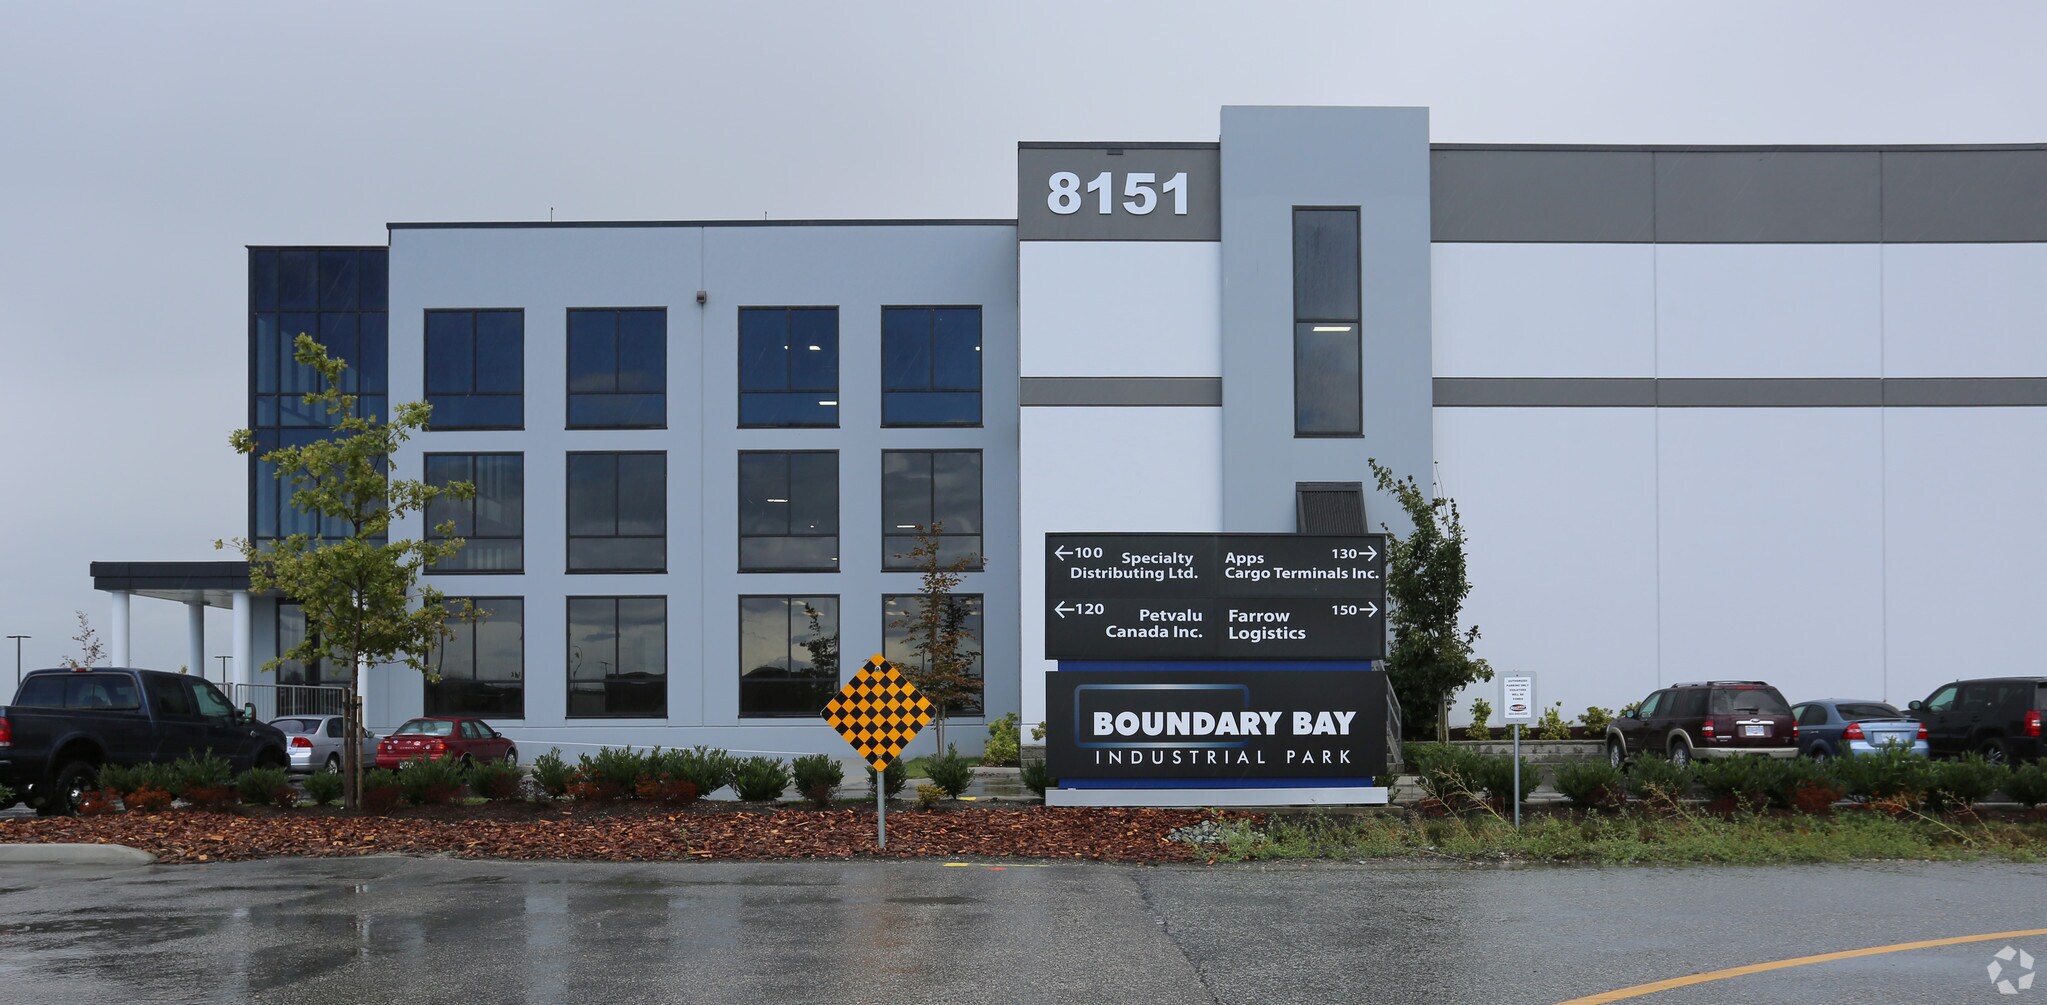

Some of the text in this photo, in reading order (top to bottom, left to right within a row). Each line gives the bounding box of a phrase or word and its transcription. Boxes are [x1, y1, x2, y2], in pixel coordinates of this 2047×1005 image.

[1047, 171, 1188, 215] 8151
[1074, 547, 1103, 559] 100
[1121, 551, 1194, 567] Specialty
[1224, 551, 1265, 567] Apps
[1331, 548, 1357, 559] 130
[1070, 566, 1199, 582] Distributing Ltd.
[1224, 566, 1380, 582] Cargo Terminals Inc.
[1075, 603, 1105, 615] 120
[1139, 608, 1203, 622] Petvalu
[1228, 609, 1291, 623] Farrow
[1331, 604, 1357, 616] 150
[1105, 624, 1203, 638] Canada Inc.
[1228, 625, 1306, 643] Logistics
[1093, 711, 1357, 737] BOUNDARY BAY
[1096, 749, 1351, 765] INDUSTRIAL PARK
